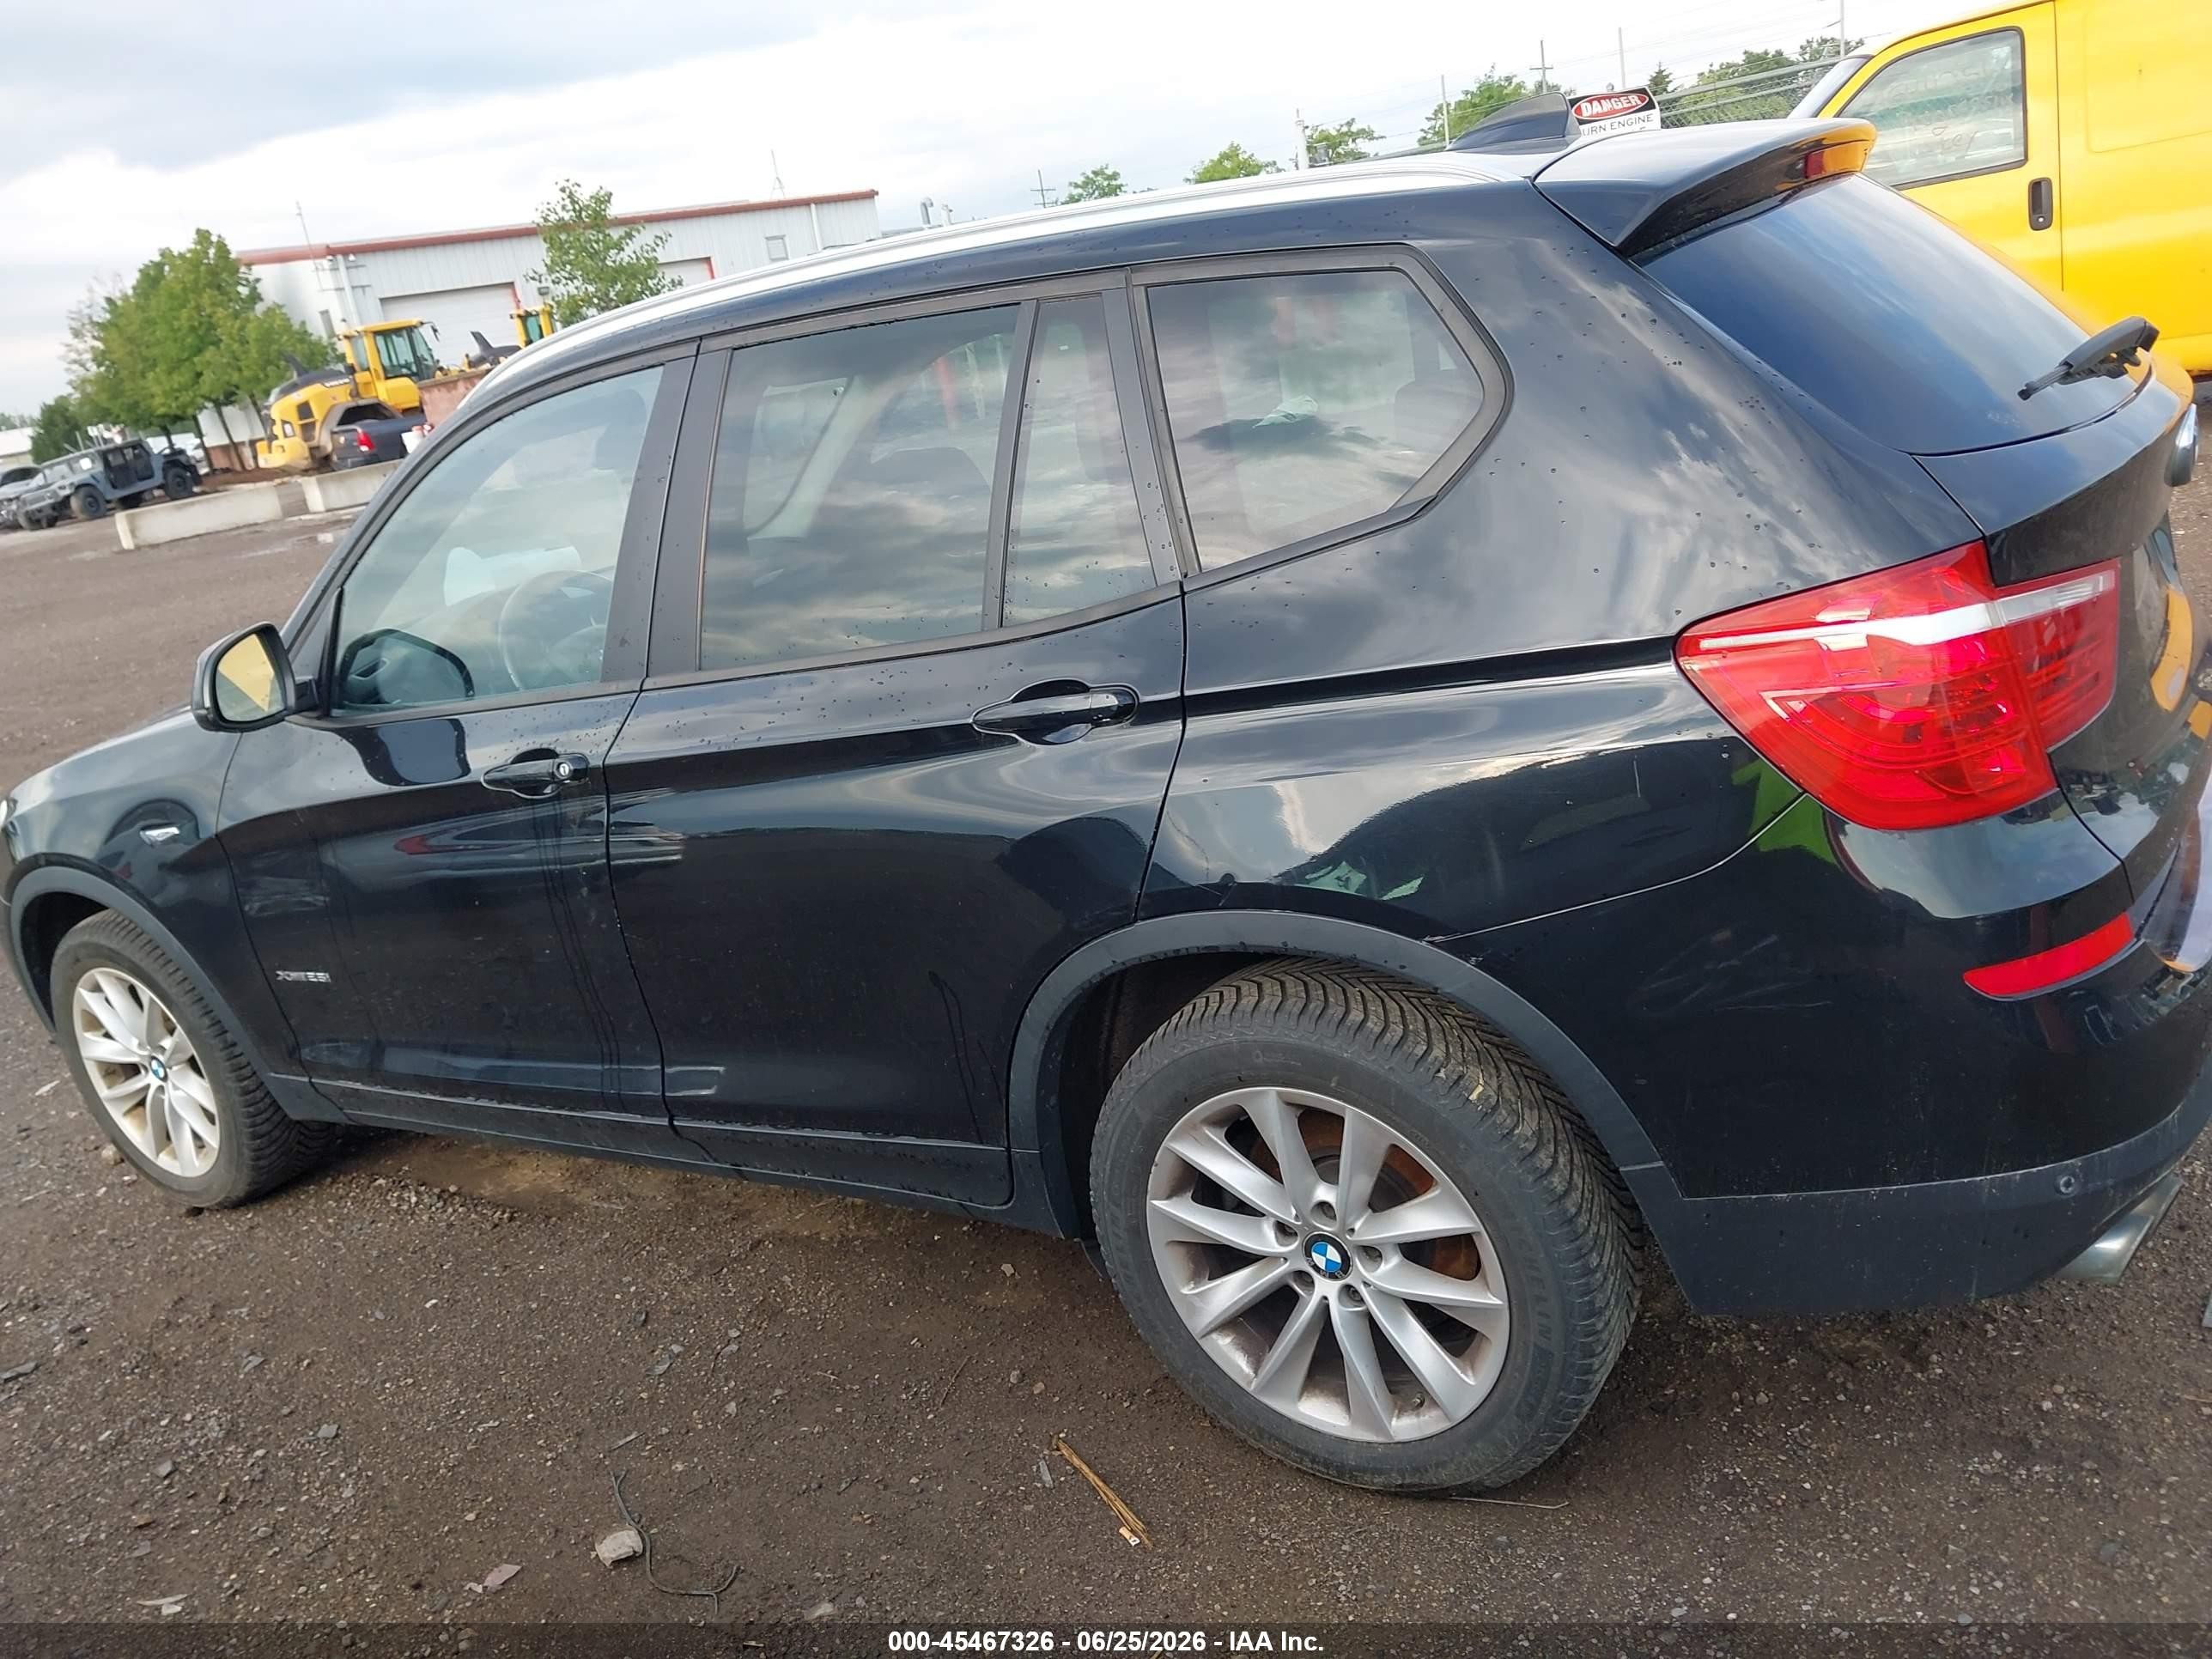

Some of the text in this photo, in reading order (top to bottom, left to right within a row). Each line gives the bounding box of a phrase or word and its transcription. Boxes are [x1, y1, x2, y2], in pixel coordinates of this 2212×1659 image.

[1581, 94, 1641, 117] DANGER
[1582, 112, 1654, 137] URN ENGINE
